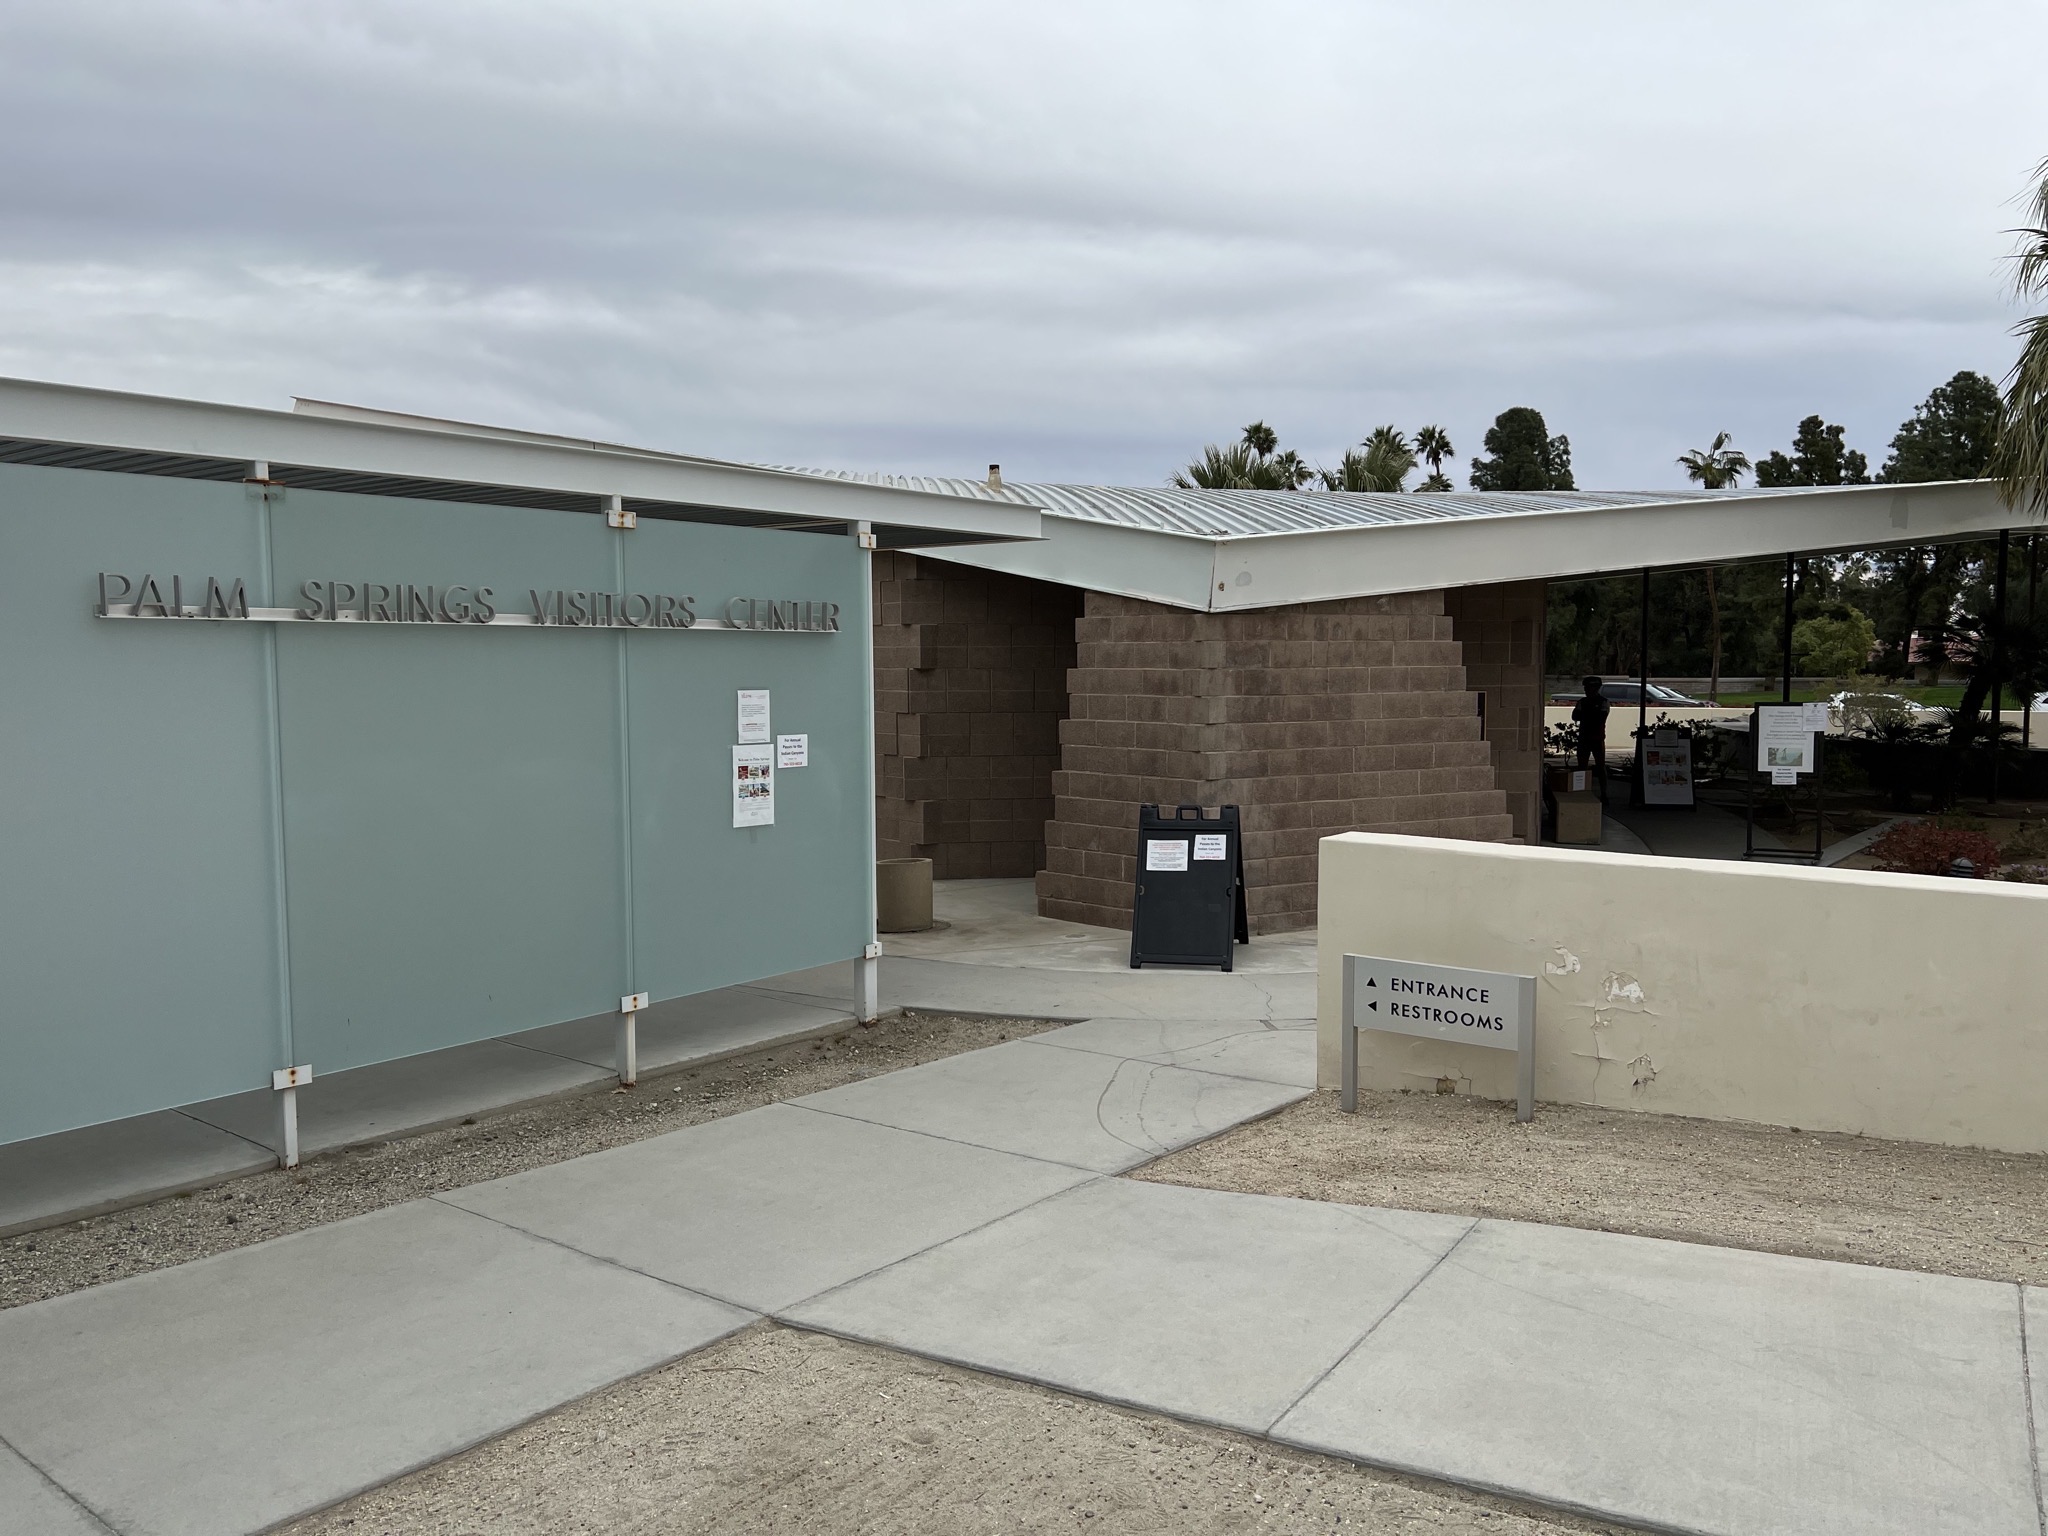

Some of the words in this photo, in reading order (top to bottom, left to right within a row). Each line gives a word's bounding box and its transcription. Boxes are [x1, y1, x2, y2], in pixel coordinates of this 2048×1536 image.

[98, 571, 249, 619] PALM
[299, 578, 495, 624] SPRINGS
[529, 588, 697, 628] VISITORS
[723, 596, 840, 631] CENTER
[1390, 977, 1490, 1003] ENTRANCE
[1390, 1001, 1504, 1031] RESTROOMS
